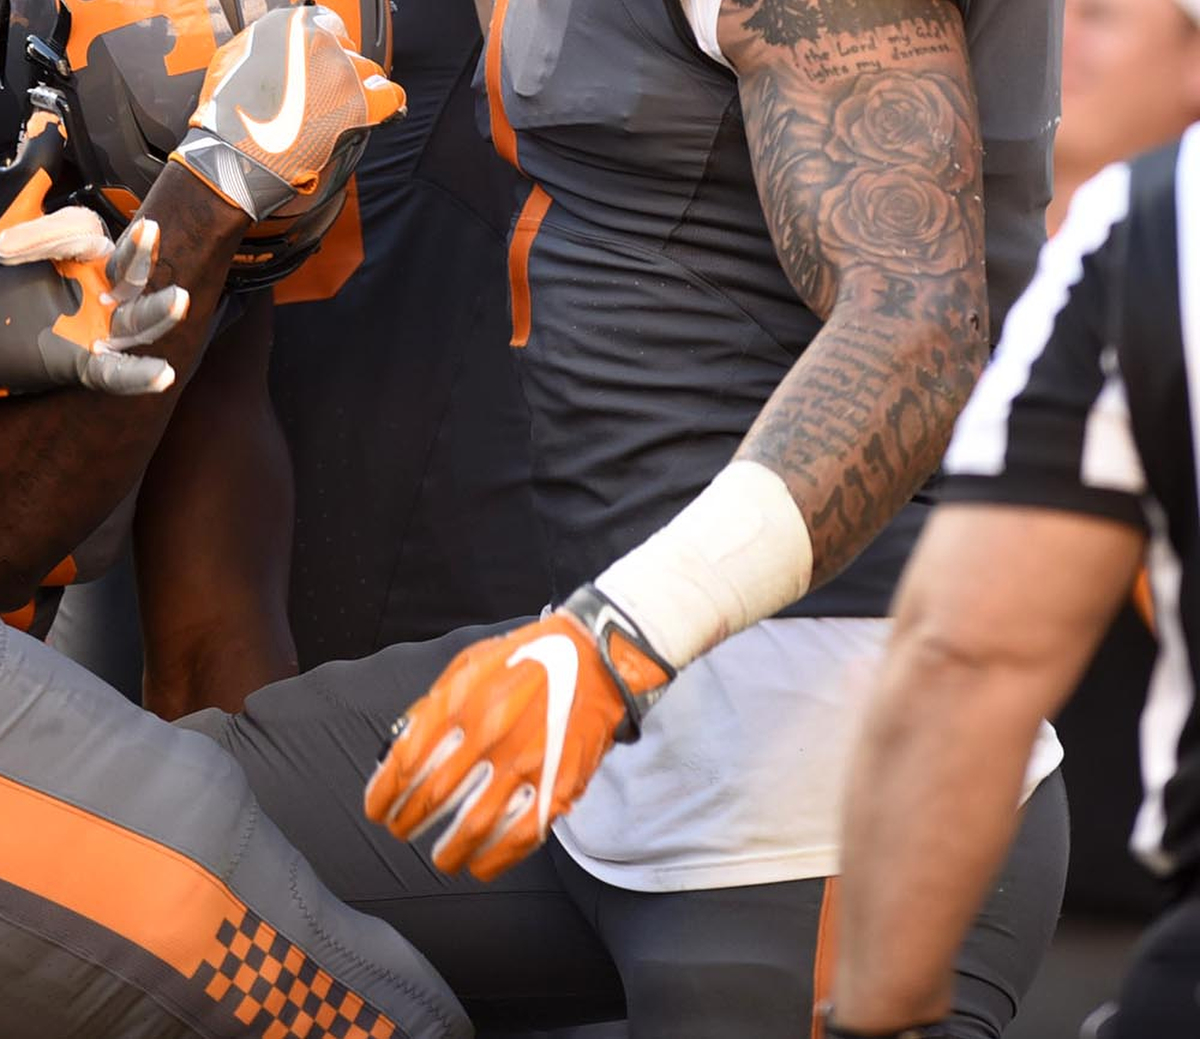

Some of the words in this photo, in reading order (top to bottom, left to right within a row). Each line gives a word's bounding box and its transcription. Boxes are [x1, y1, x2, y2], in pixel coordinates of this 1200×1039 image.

[836, 36, 876, 57] Lord
[887, 34, 911, 46] my
[856, 59, 883, 71] my
